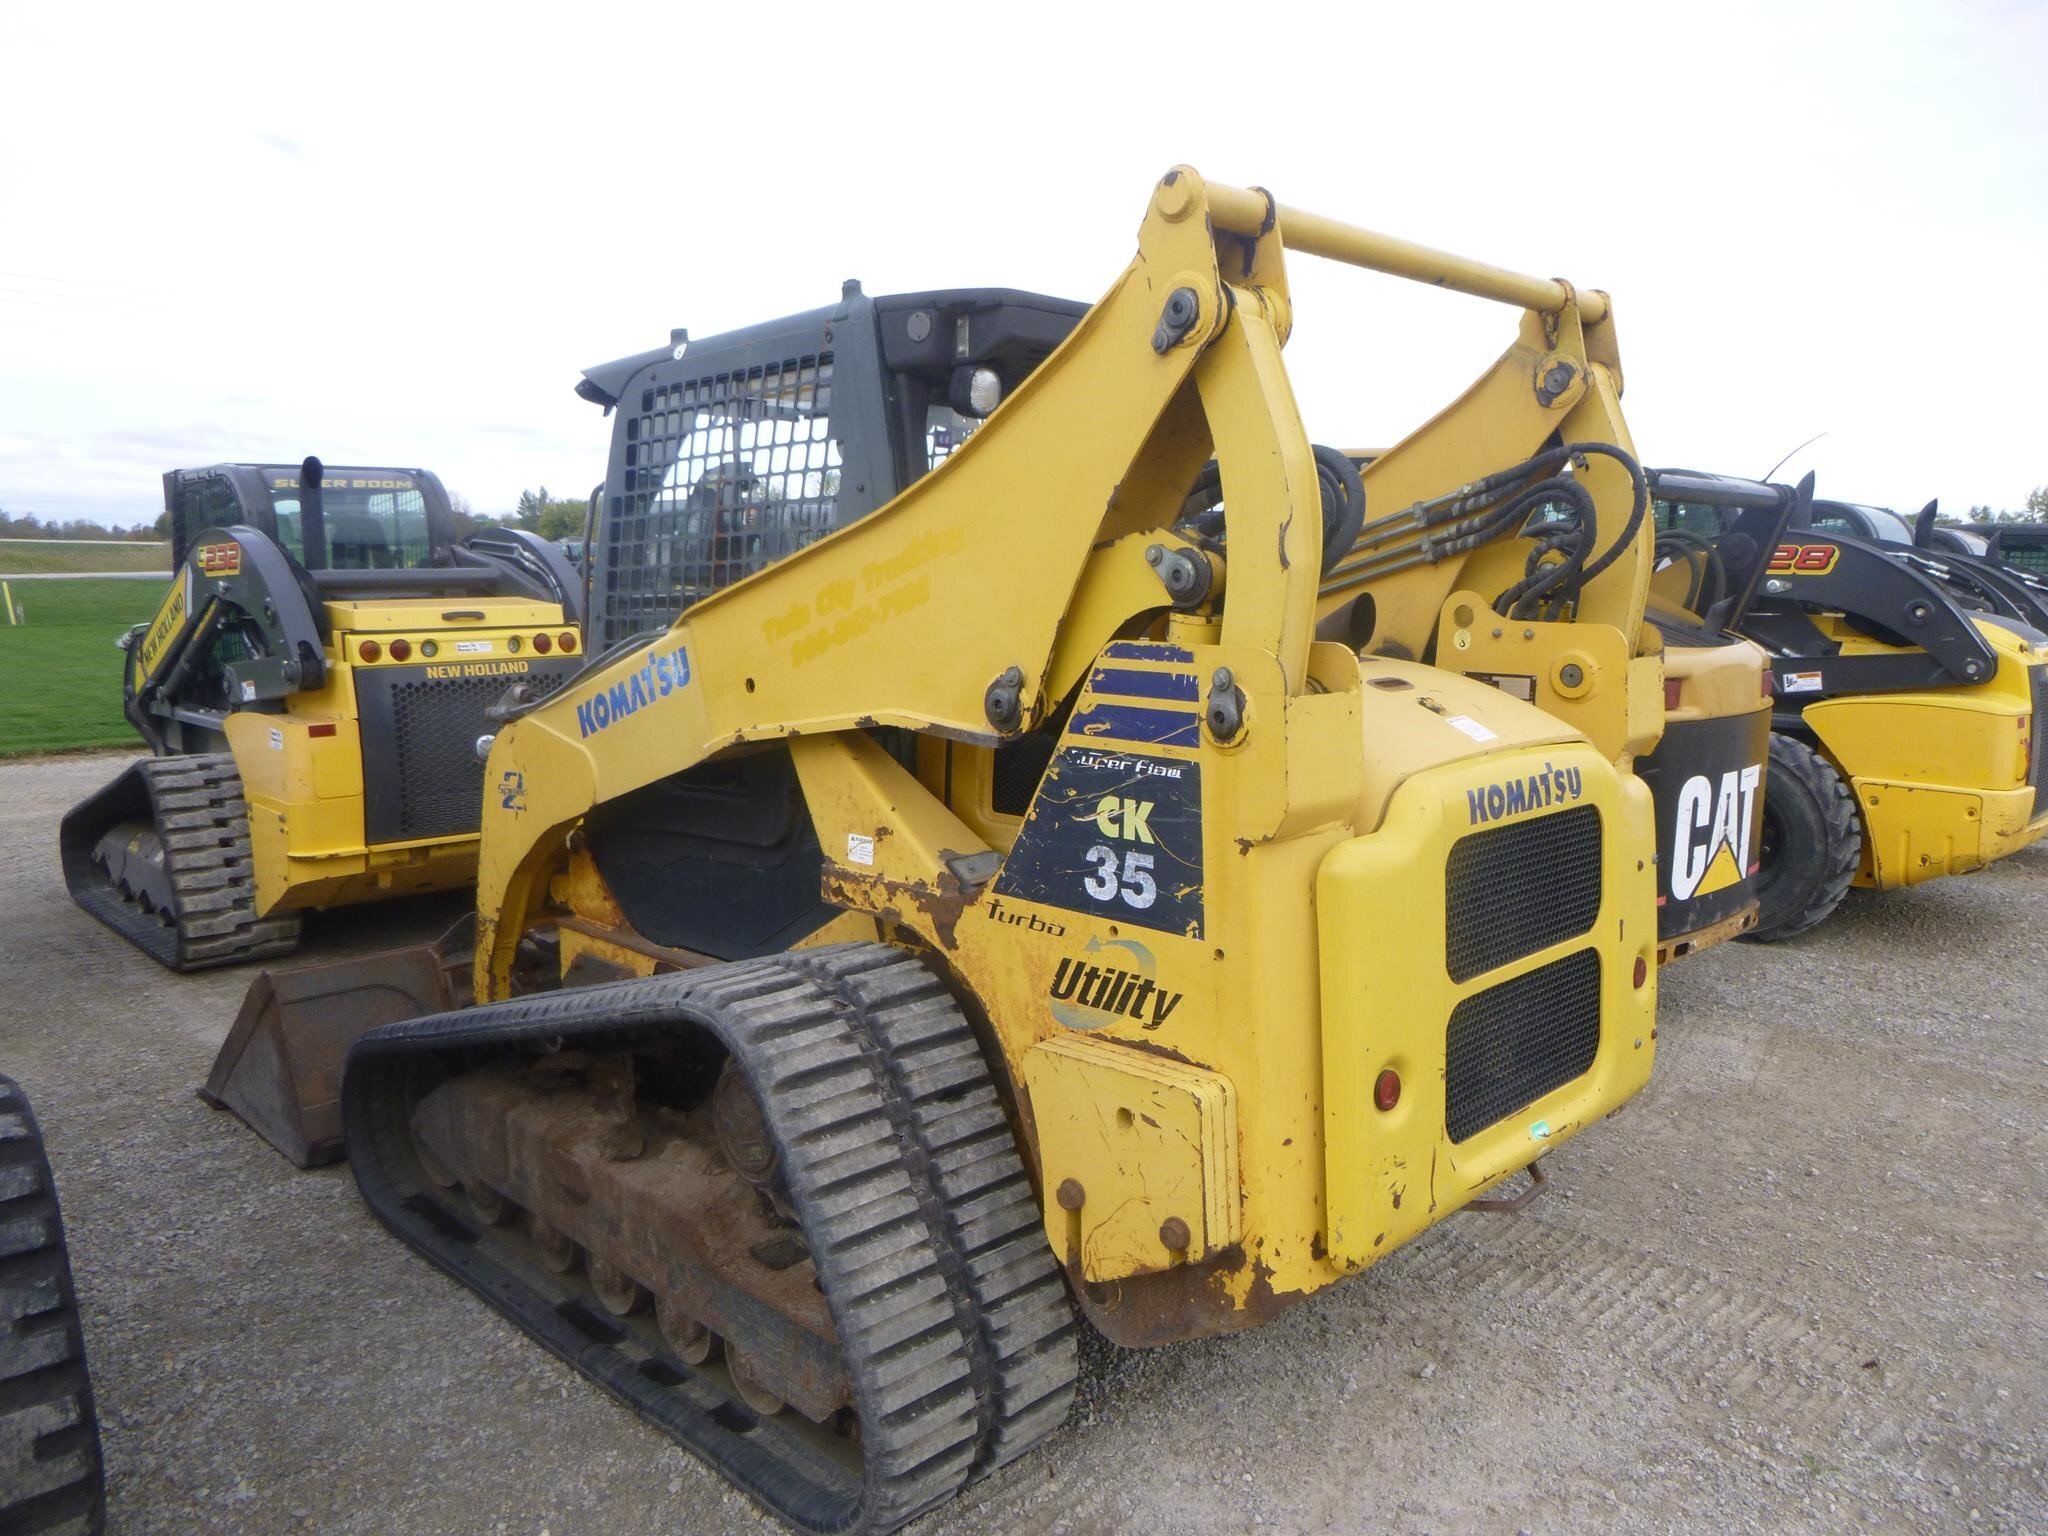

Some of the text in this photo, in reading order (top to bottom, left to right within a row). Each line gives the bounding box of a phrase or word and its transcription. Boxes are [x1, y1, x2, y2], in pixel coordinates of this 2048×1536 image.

[274, 479, 412, 488] SUER BOOM
[427, 661, 528, 679] NEW HOLLAND
[577, 646, 690, 739] KOMATSU
[1096, 795, 1155, 844] CK
[1466, 762, 1581, 825] KOMATSU
[1671, 763, 1762, 900] CAT
[1084, 845, 1157, 909] 35
[986, 901, 1066, 937] Turbo
[1049, 957, 1183, 1031] Utility
